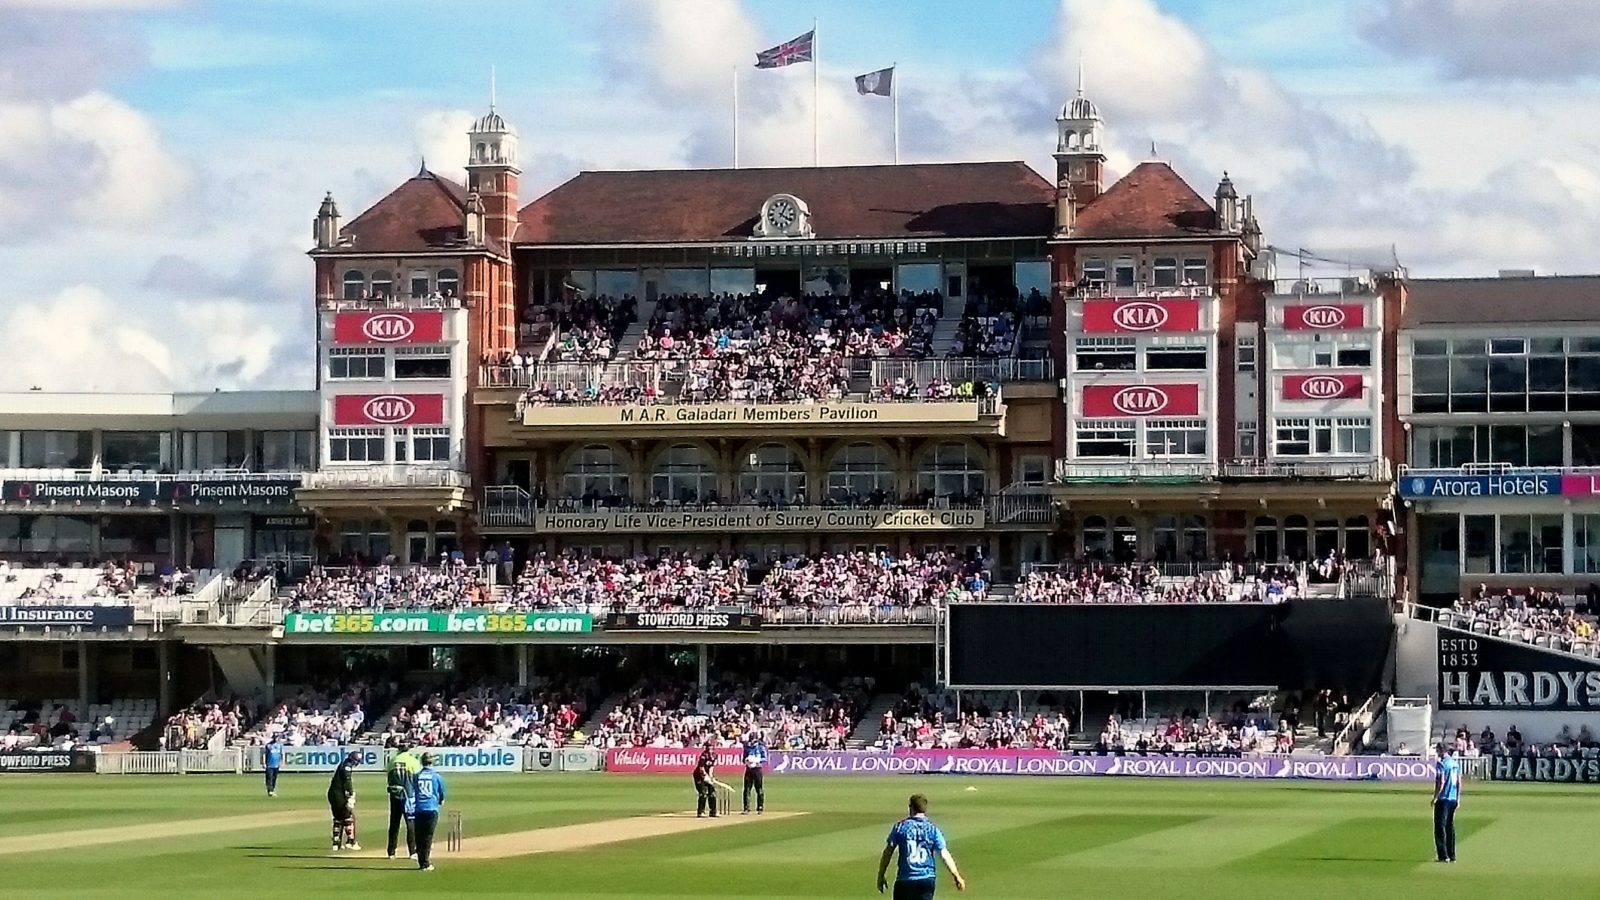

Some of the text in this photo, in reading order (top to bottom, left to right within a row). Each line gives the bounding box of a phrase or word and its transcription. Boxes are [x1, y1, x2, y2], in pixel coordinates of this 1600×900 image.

[1122, 308, 1159, 324] KIA
[1309, 310, 1338, 324] KIA
[371, 320, 406, 336] KIA
[1309, 380, 1338, 394] KIA
[1122, 392, 1159, 408] KIA
[371, 401, 406, 417] KIA
[676, 407, 737, 421] Galadari
[819, 406, 878, 420] Pavilion
[35, 483, 140, 497] Pinsent Masons
[191, 483, 289, 497] Pinsent Masons
[1431, 475, 1548, 496] Arora Hotels
[1591, 475, 1600, 494] L
[545, 512, 975, 531] Honorary Life Vice-President of Surrey County Cricket Club
[11, 606, 94, 620] Insurance
[637, 614, 729, 627] STOWFORD PRESS
[294, 615, 429, 633] bet365.com
[447, 614, 583, 632] bet365.com
[1441, 639, 1478, 651] ESTD
[1442, 653, 1478, 666] 1853
[1442, 671, 1600, 706] HARDYS
[0, 755, 70, 767] OWFORD PRESS
[614, 750, 651, 770] Vitality
[654, 753, 696, 766] HEALTH
[790, 756, 931, 771] ROYAL LONDON
[956, 758, 1097, 774] ROYAL LONDON
[1122, 759, 1267, 776] ROYAL LONDON
[1293, 761, 1437, 777] ROYAL LONDON
[1495, 756, 1600, 781] HARDYS
